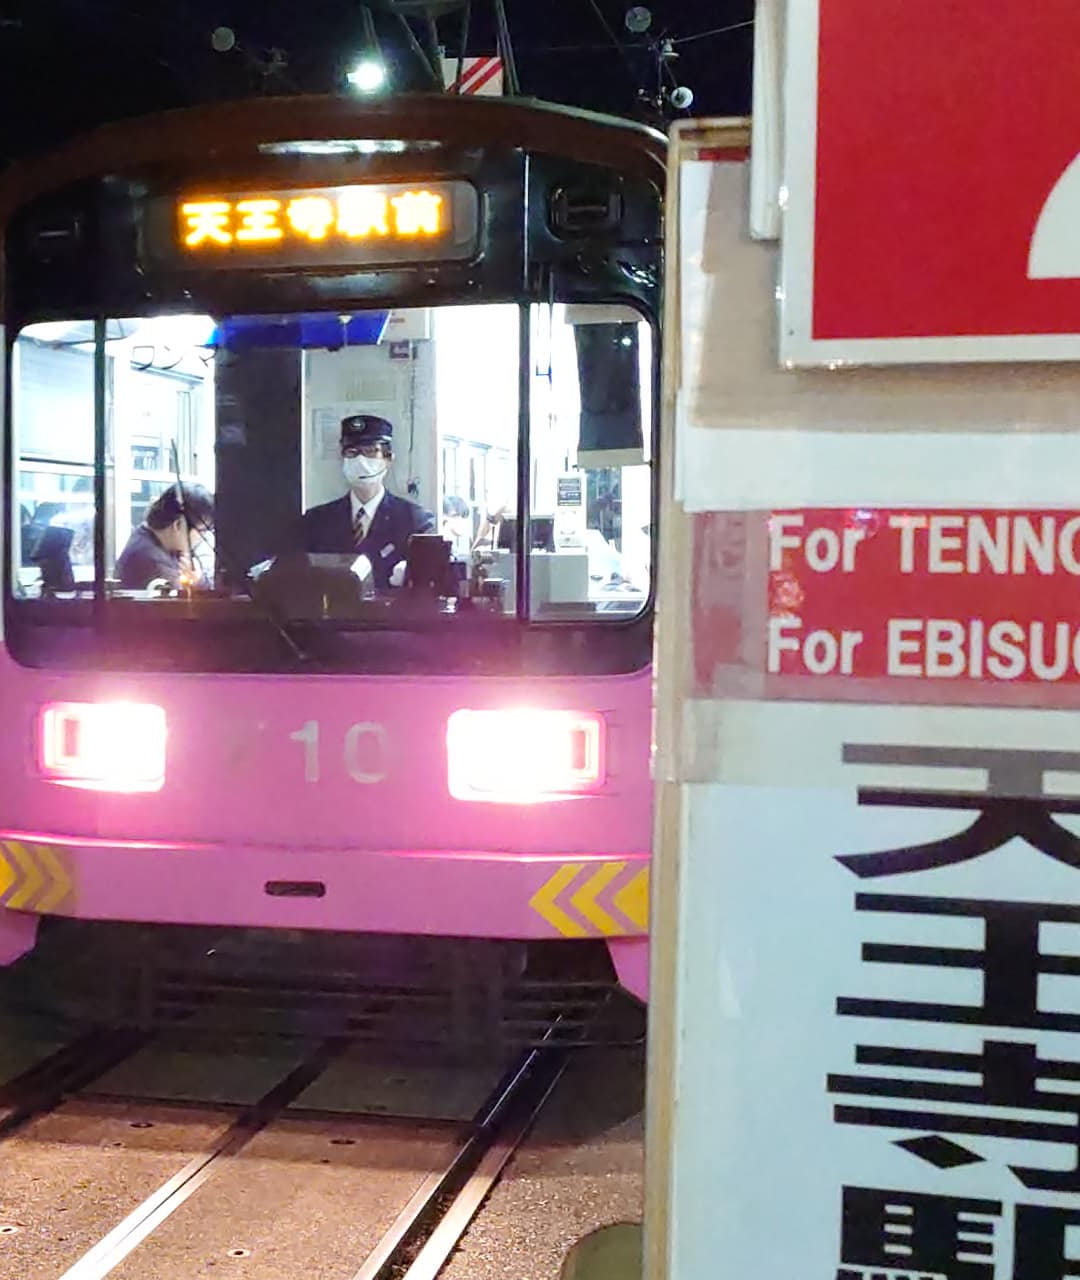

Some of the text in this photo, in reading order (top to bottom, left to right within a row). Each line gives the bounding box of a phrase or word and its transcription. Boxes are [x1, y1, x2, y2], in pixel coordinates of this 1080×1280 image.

[769, 514, 865, 572] For
[768, 614, 1080, 680] For EBISU
